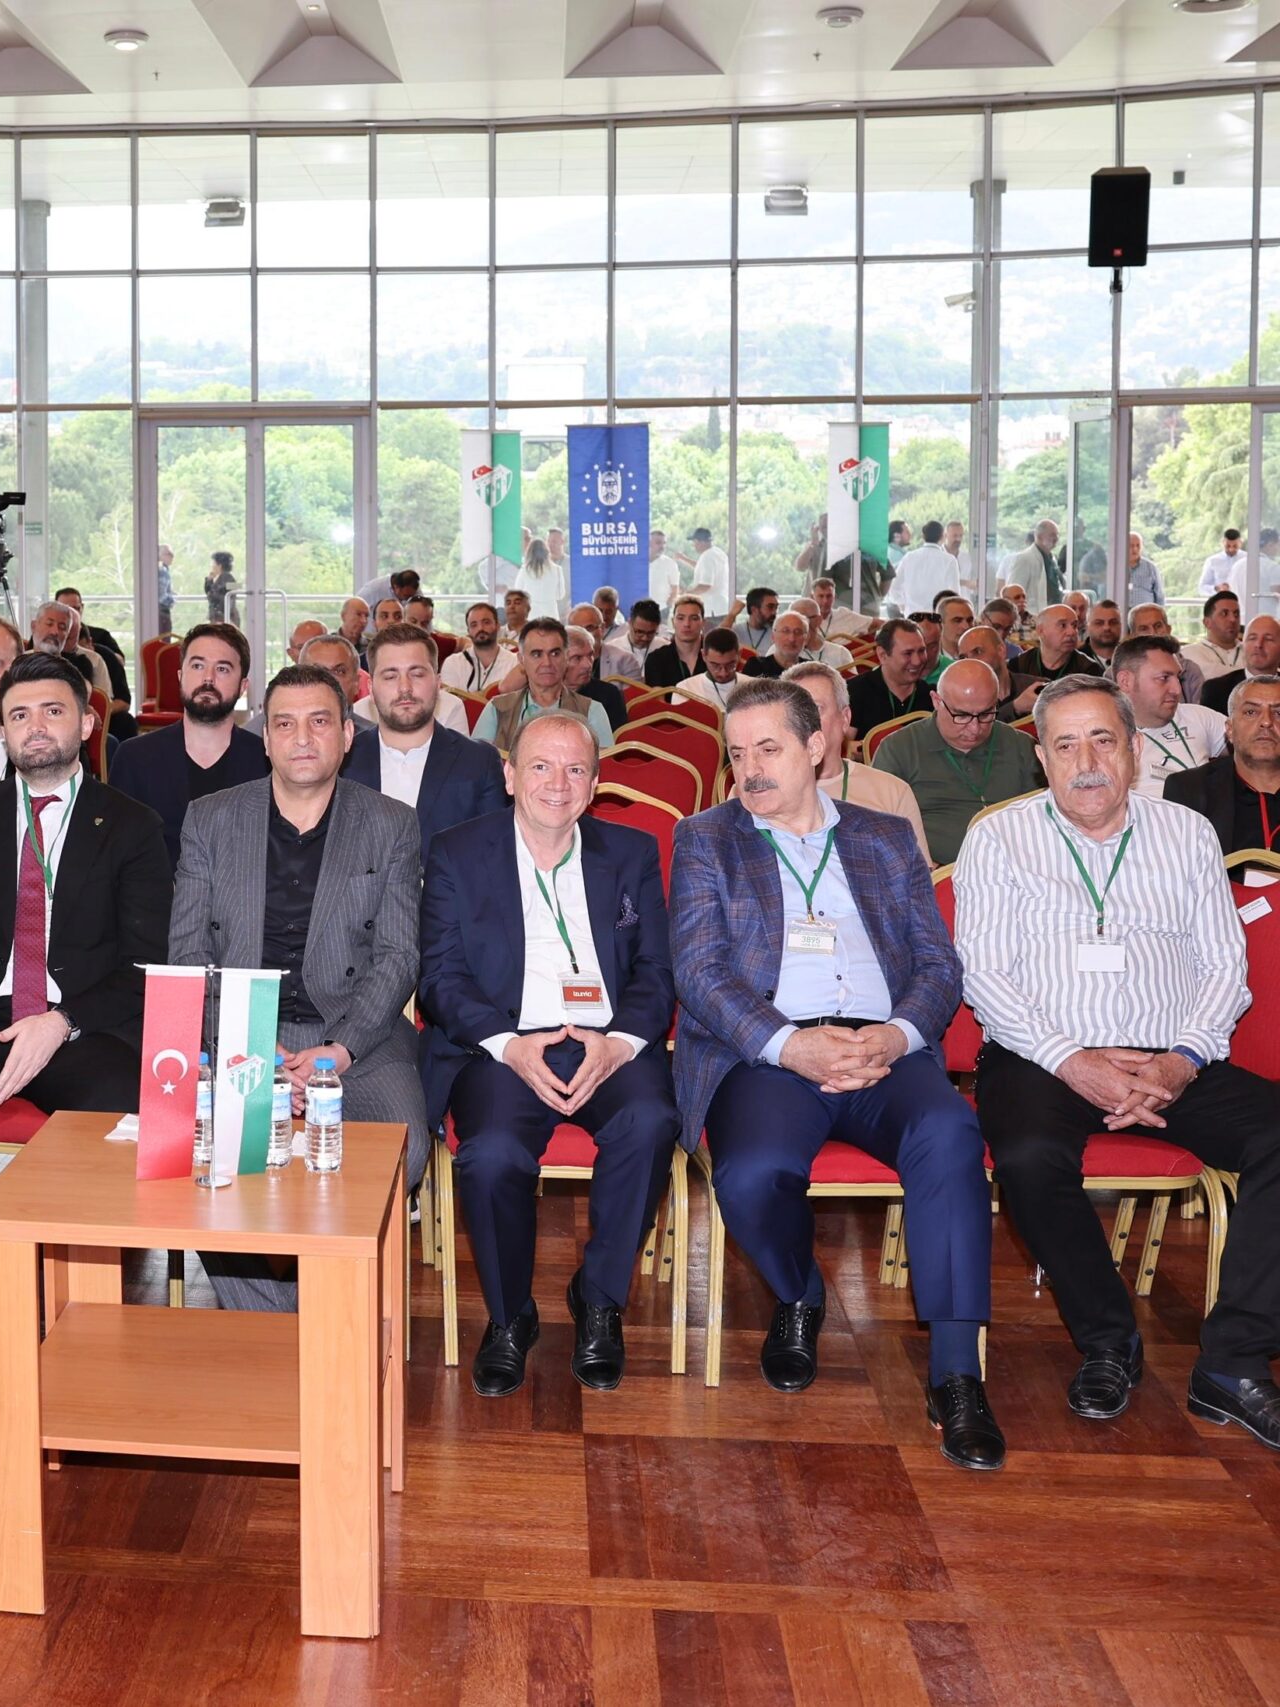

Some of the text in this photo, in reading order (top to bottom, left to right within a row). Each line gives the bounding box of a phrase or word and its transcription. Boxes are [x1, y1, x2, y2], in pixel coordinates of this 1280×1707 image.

[581, 522, 638, 536] BURSA
[582, 533, 638, 546] BÜYÜKŞEHİR
[582, 544, 639, 556] BELEDİYESİ
